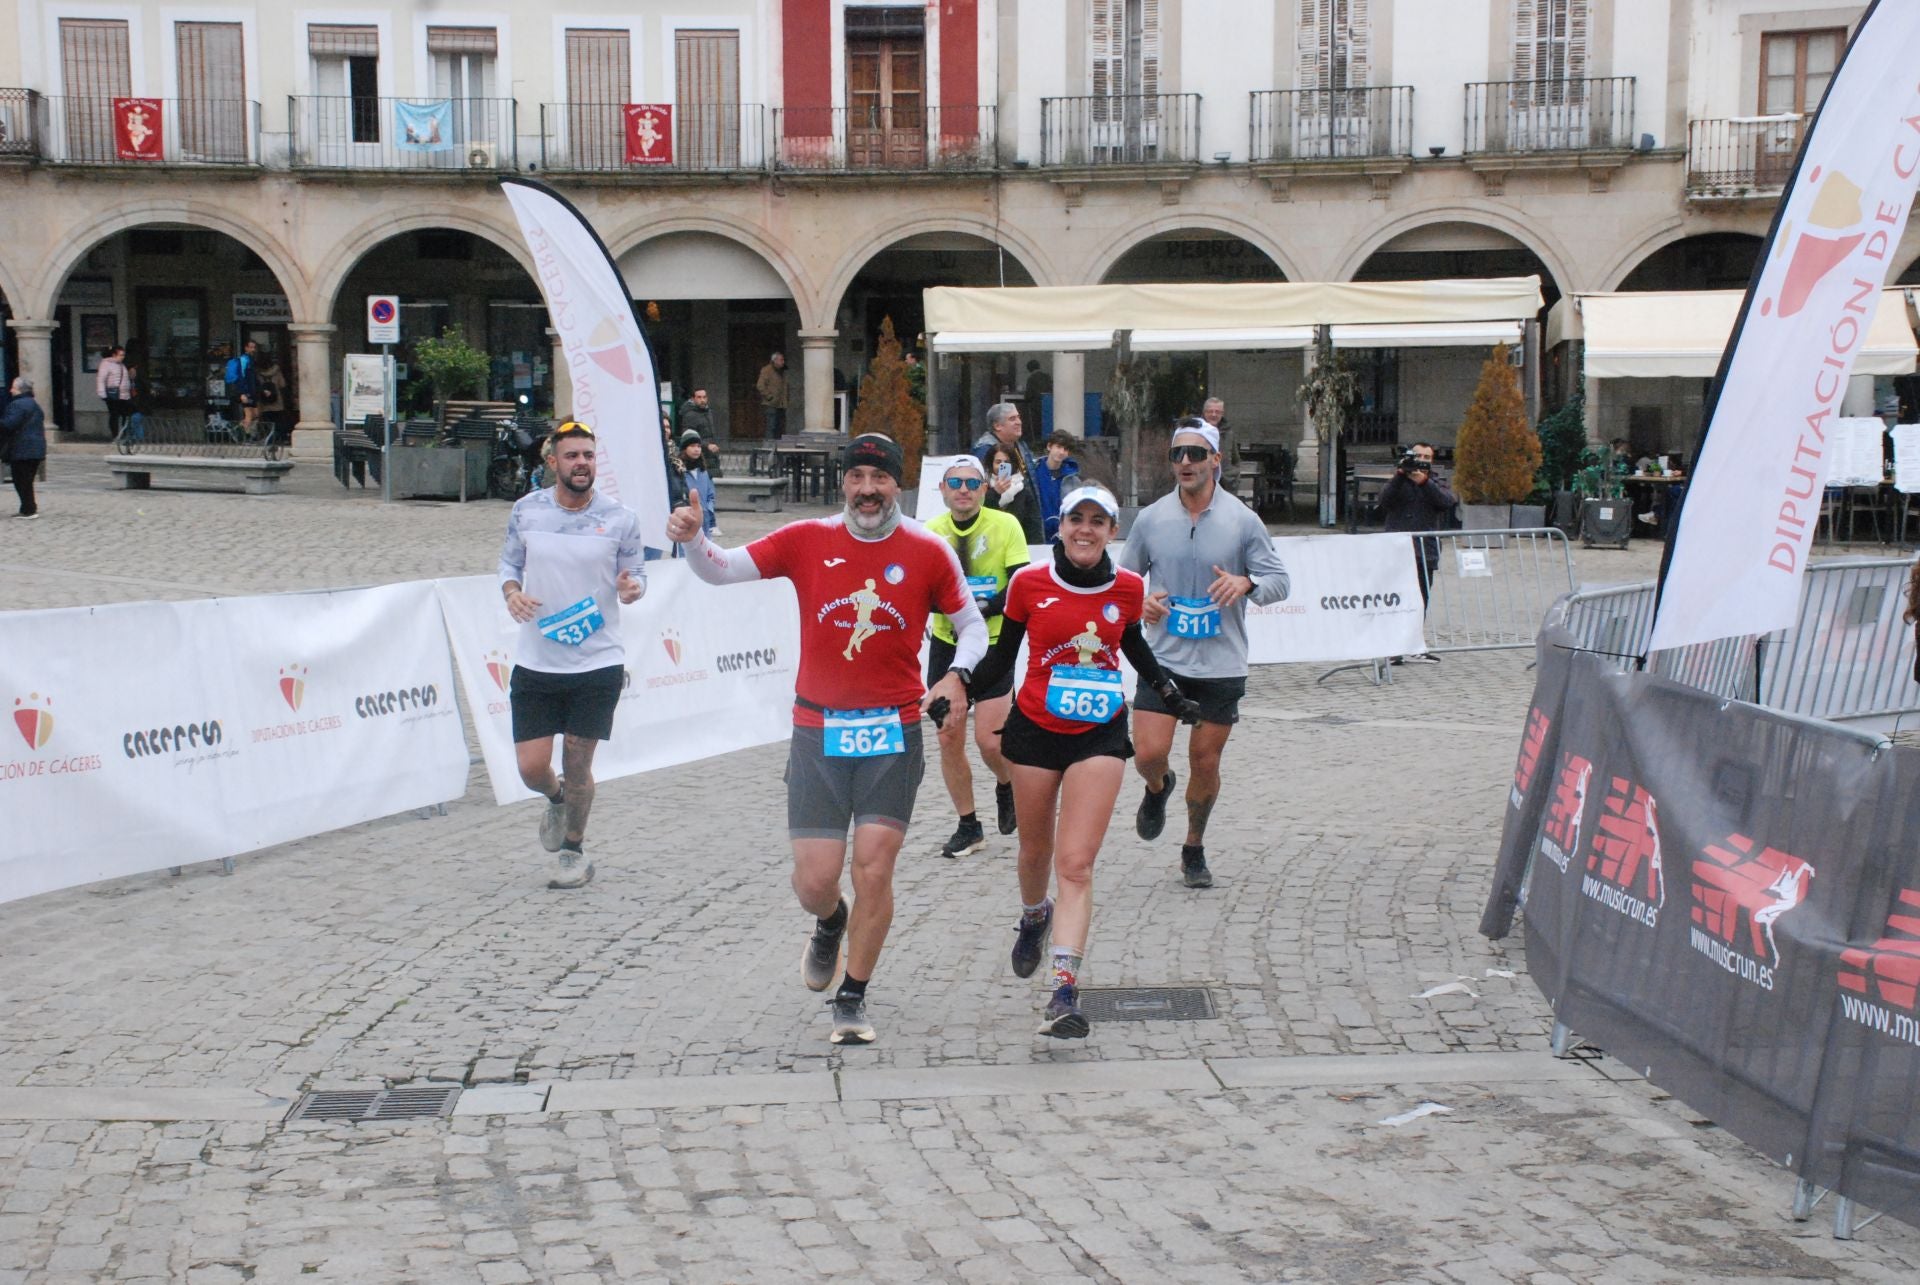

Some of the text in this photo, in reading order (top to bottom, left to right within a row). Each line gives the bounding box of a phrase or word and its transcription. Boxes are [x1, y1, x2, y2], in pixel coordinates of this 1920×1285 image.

[1767, 277, 1875, 575] DIPUTACIÓN
[1863, 200, 1903, 262] DE
[817, 596, 856, 624] Atletas
[833, 619, 852, 629] Valle
[1177, 613, 1210, 635] 511
[557, 617, 594, 646] 531
[1059, 690, 1110, 719] 563
[839, 727, 890, 754] 562
[28, 760, 46, 777] DE
[49, 754, 103, 774] CÁCERES
[1690, 926, 1774, 991] www.musicrun.es
